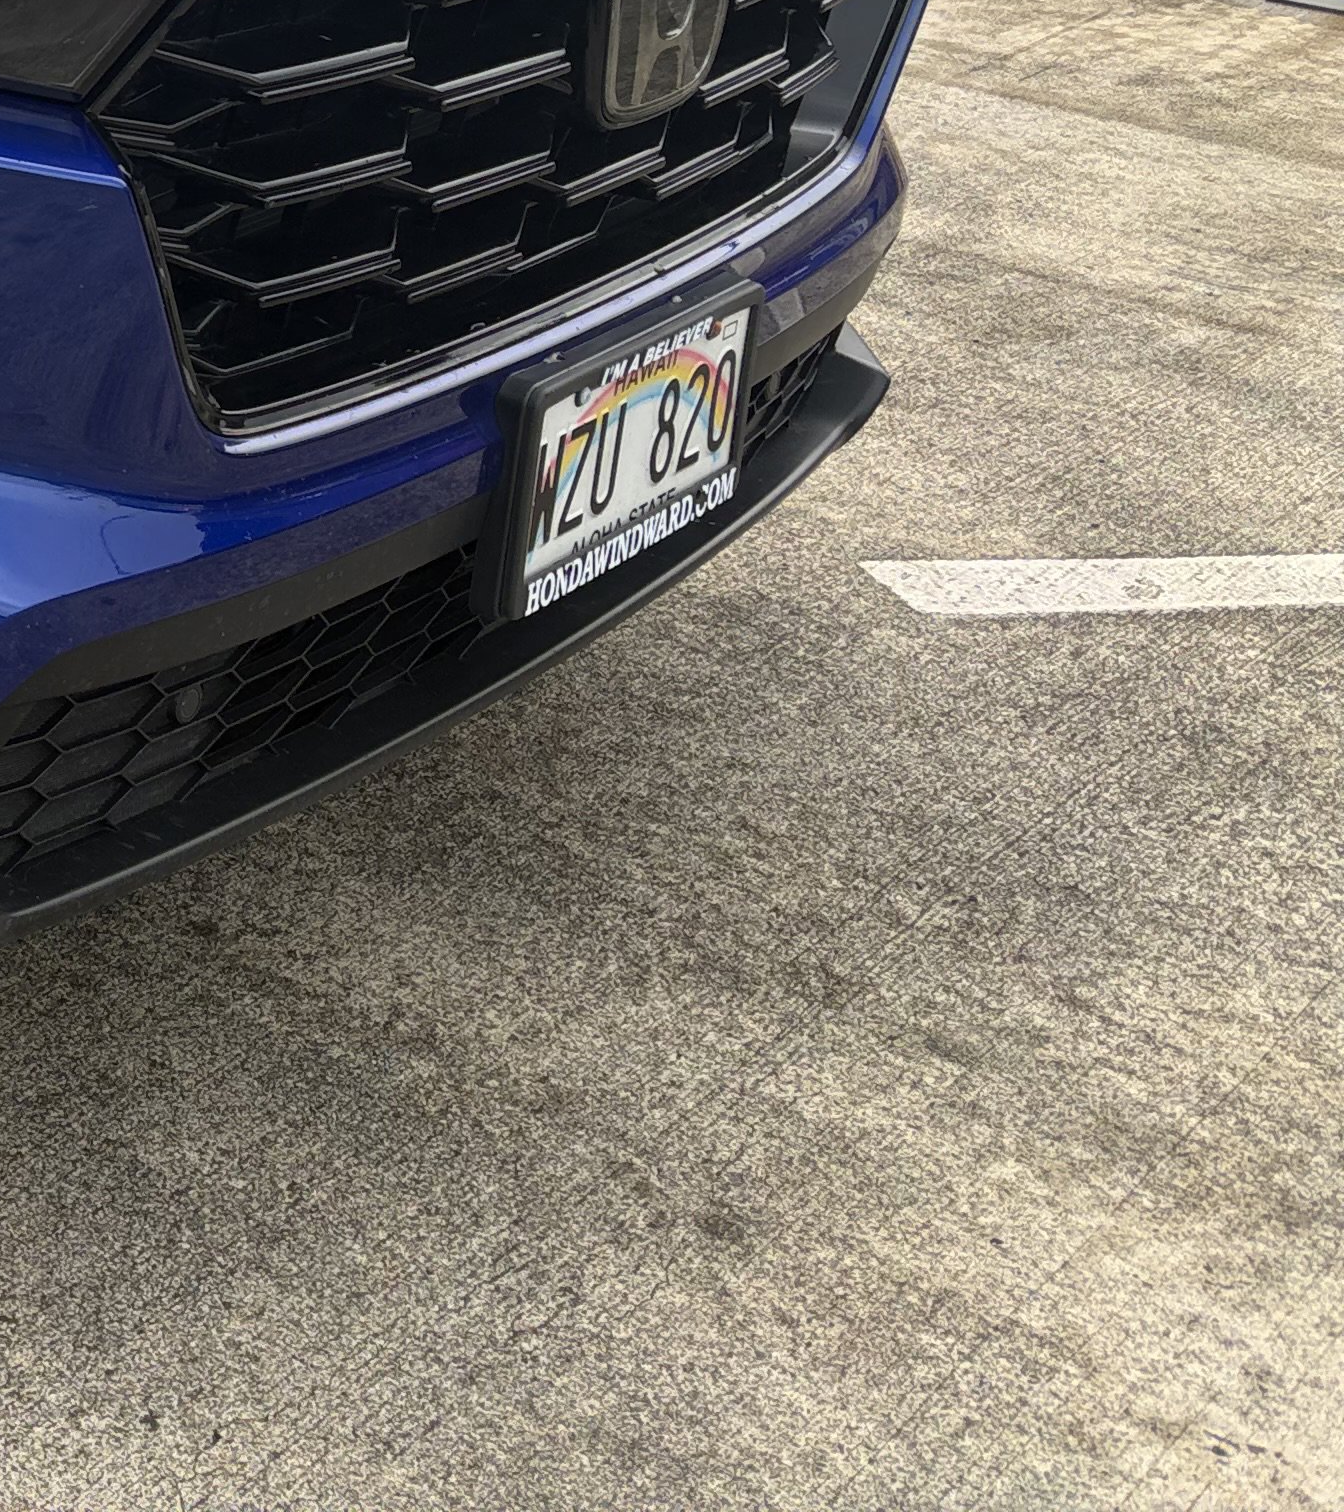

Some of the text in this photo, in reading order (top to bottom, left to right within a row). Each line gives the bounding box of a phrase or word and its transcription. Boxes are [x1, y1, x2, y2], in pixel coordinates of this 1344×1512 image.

[601, 316, 714, 387] I'M A BELIEVER
[614, 349, 680, 396] HAWAII
[528, 348, 737, 553] WZU 820
[525, 466, 737, 617] HONDAWINDWARD.COM
